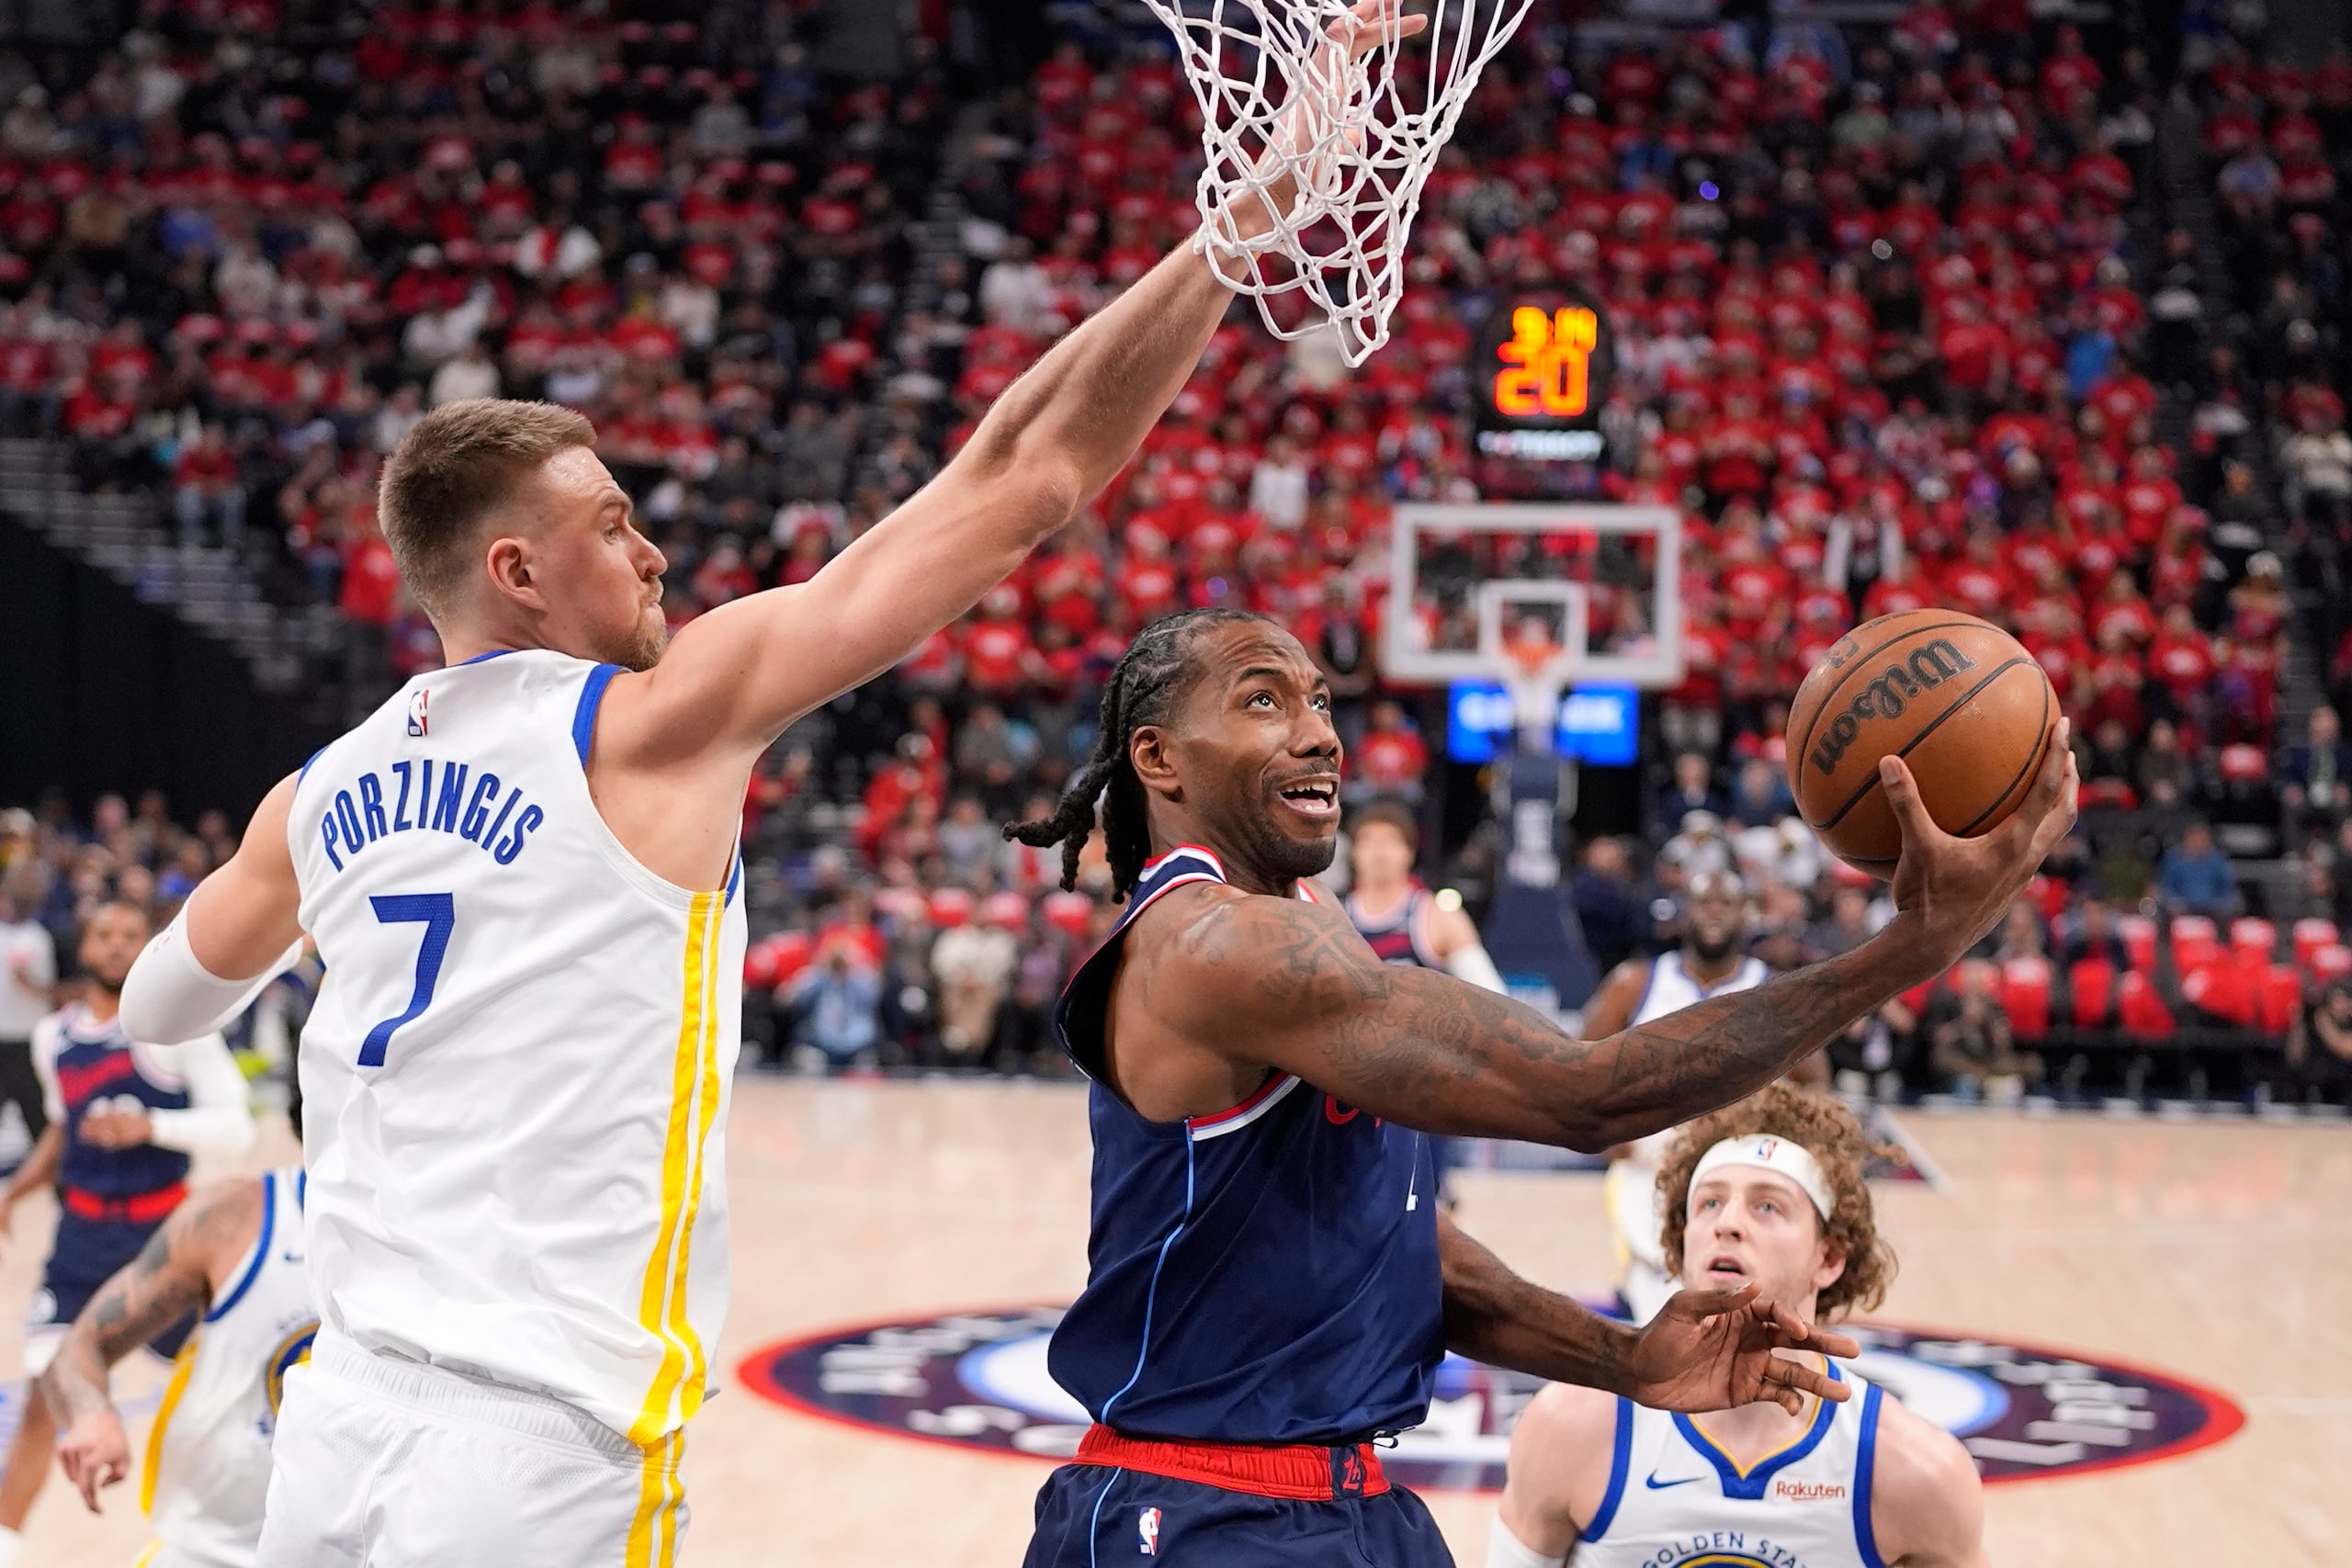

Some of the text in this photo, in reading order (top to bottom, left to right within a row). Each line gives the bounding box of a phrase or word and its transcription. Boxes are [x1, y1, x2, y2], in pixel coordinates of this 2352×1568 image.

[1495, 340, 1589, 416] 20
[1809, 637, 1977, 776] Wilson
[321, 759, 544, 873] PORZINGIS
[356, 891, 456, 1067] 7
[1775, 1481, 1846, 1499] Rakuten
[1756, 1539, 1807, 1568] STA
